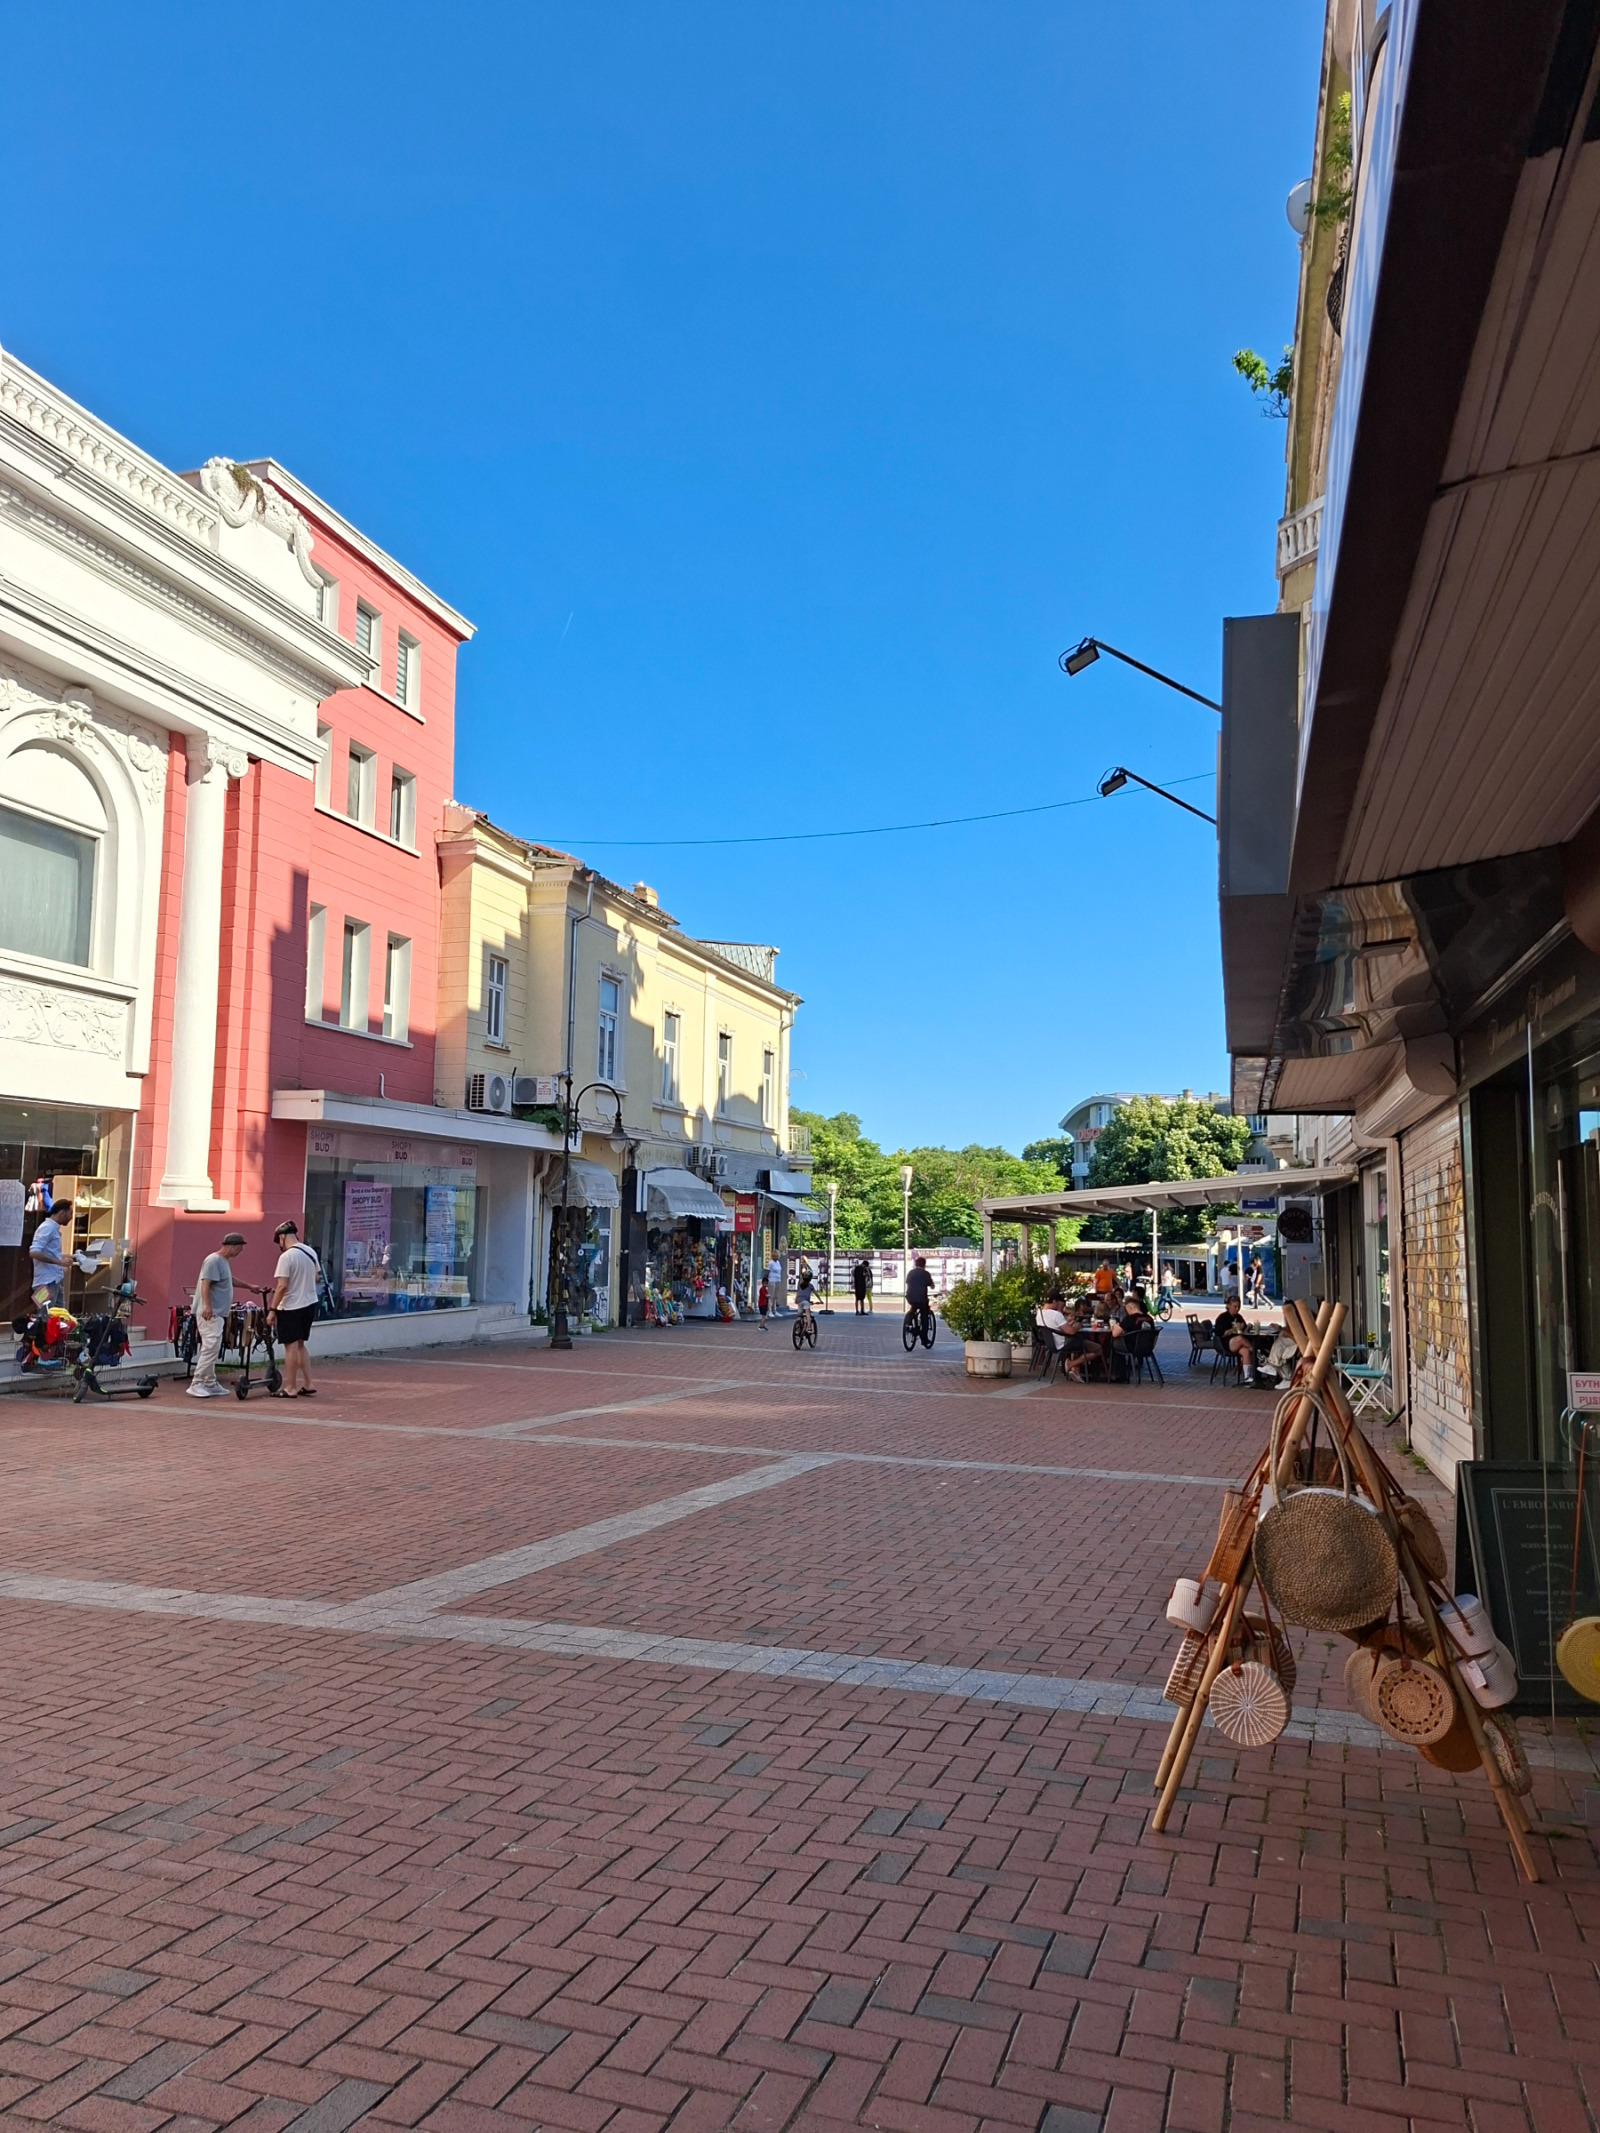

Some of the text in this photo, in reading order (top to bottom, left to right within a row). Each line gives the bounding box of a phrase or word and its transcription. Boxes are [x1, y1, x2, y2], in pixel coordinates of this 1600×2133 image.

[310, 1130, 336, 1142] SHOPY
[315, 1142, 330, 1152] BUD
[395, 1151, 408, 1160] BUD
